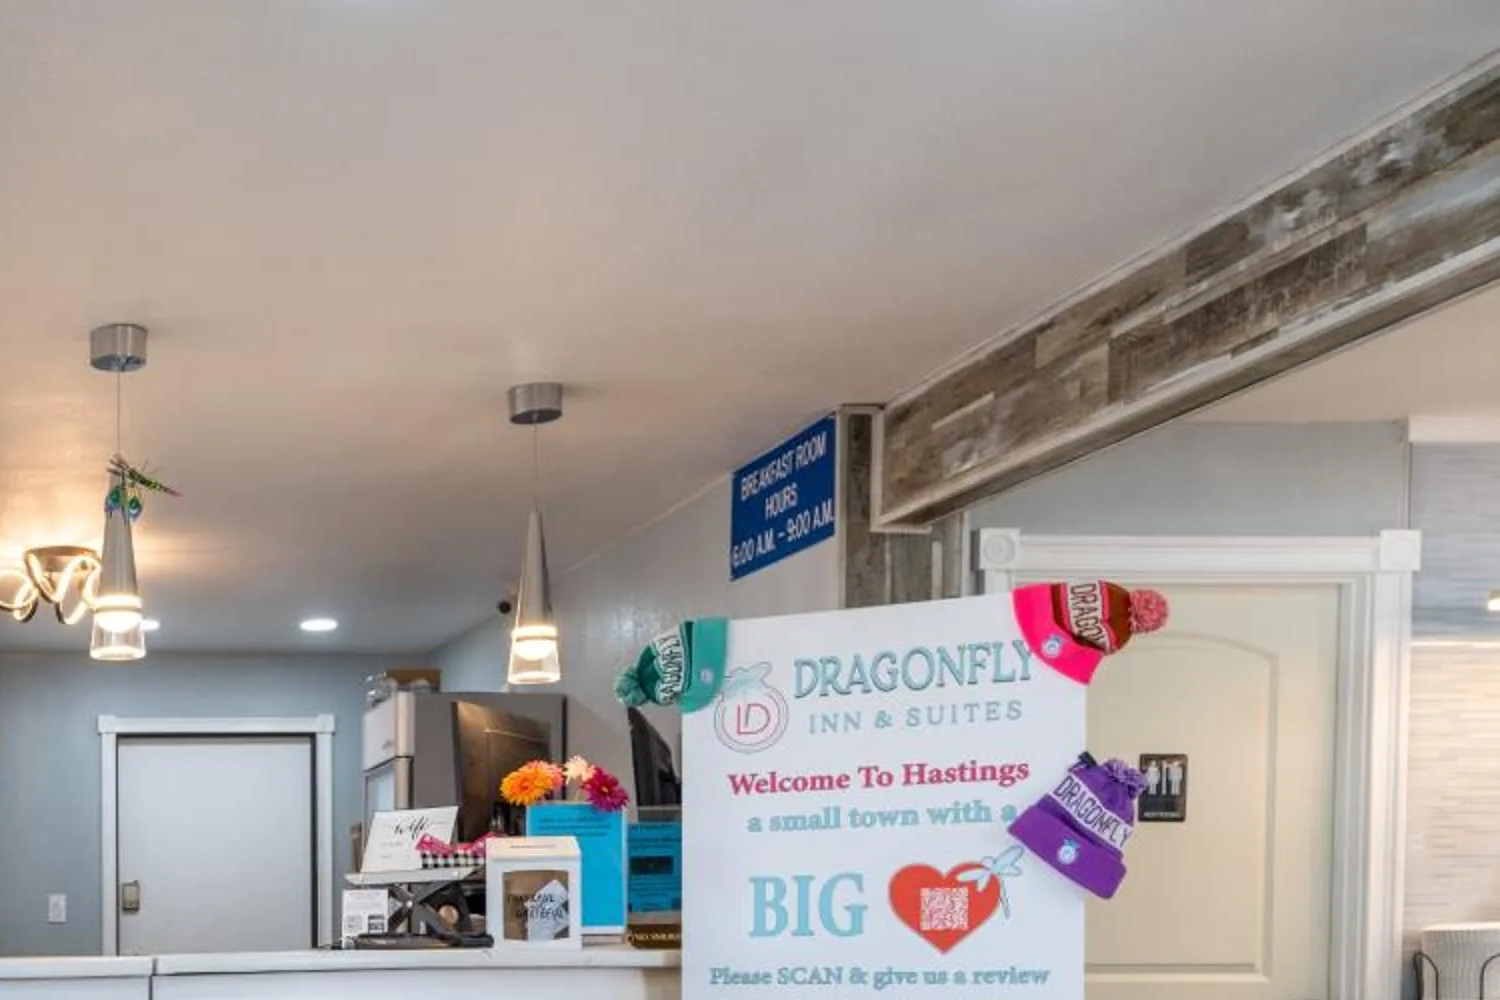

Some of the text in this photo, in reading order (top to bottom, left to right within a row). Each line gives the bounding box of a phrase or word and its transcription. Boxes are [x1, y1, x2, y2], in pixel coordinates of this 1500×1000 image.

[741, 432, 827, 501] BREAKFAST ROOM
[765, 482, 798, 520] HOURS
[794, 640, 1031, 698] DRAGONFLY
[809, 700, 1023, 734] INN & SUITES
[729, 760, 1030, 796] Welcome To Hastings
[746, 800, 1017, 832] a small town with a
[1053, 775, 1131, 848] DRAGONFLY
[749, 872, 868, 938] BIG
[709, 967, 1051, 990] Please SCAN & give us a review
